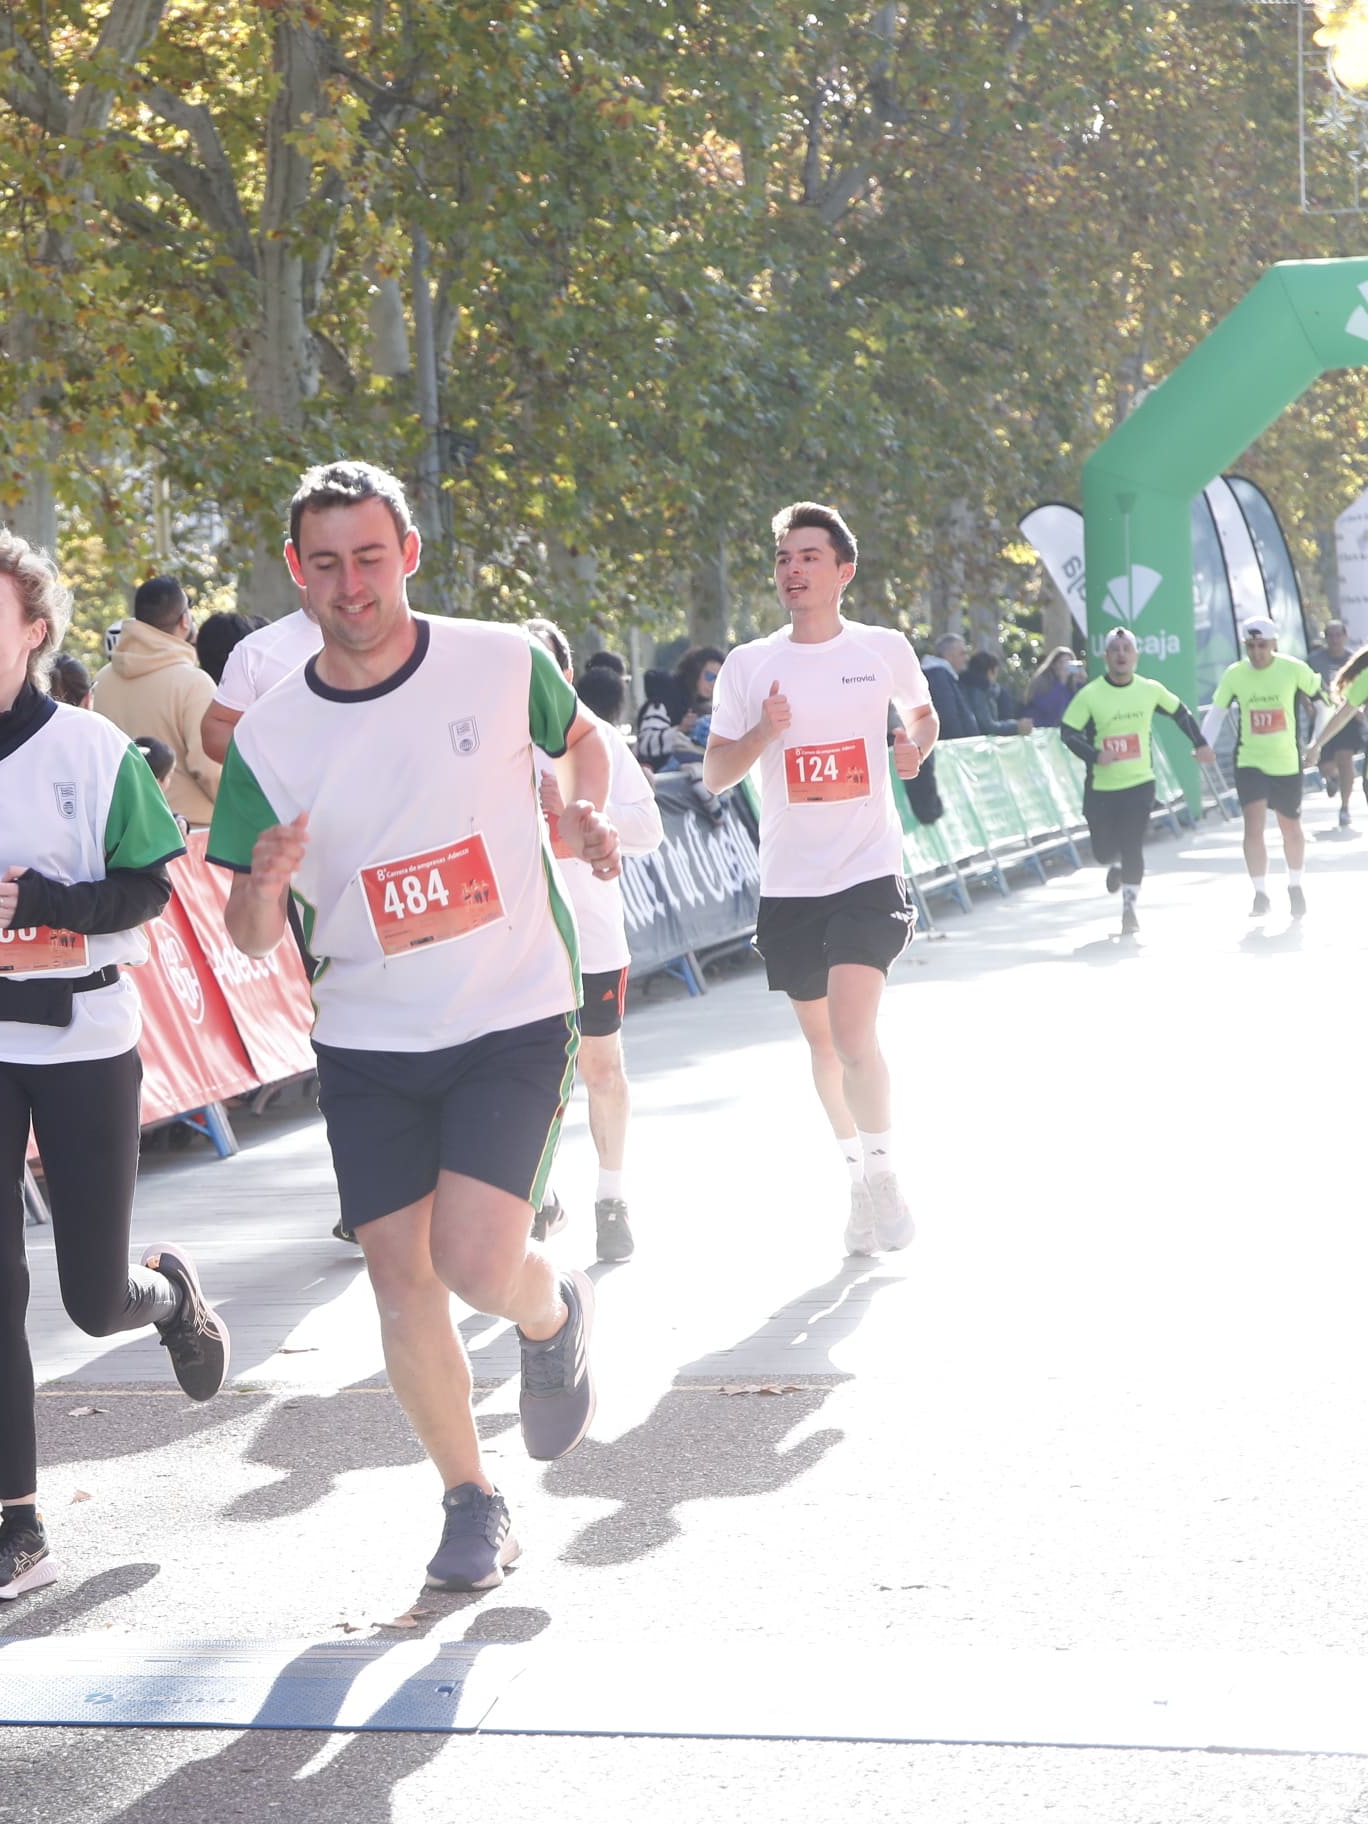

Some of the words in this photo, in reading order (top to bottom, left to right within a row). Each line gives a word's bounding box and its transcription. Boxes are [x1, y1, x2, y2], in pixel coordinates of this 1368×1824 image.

[1090, 629, 1180, 662] ucaja
[795, 754, 839, 783] 124
[384, 867, 450, 919] 484
